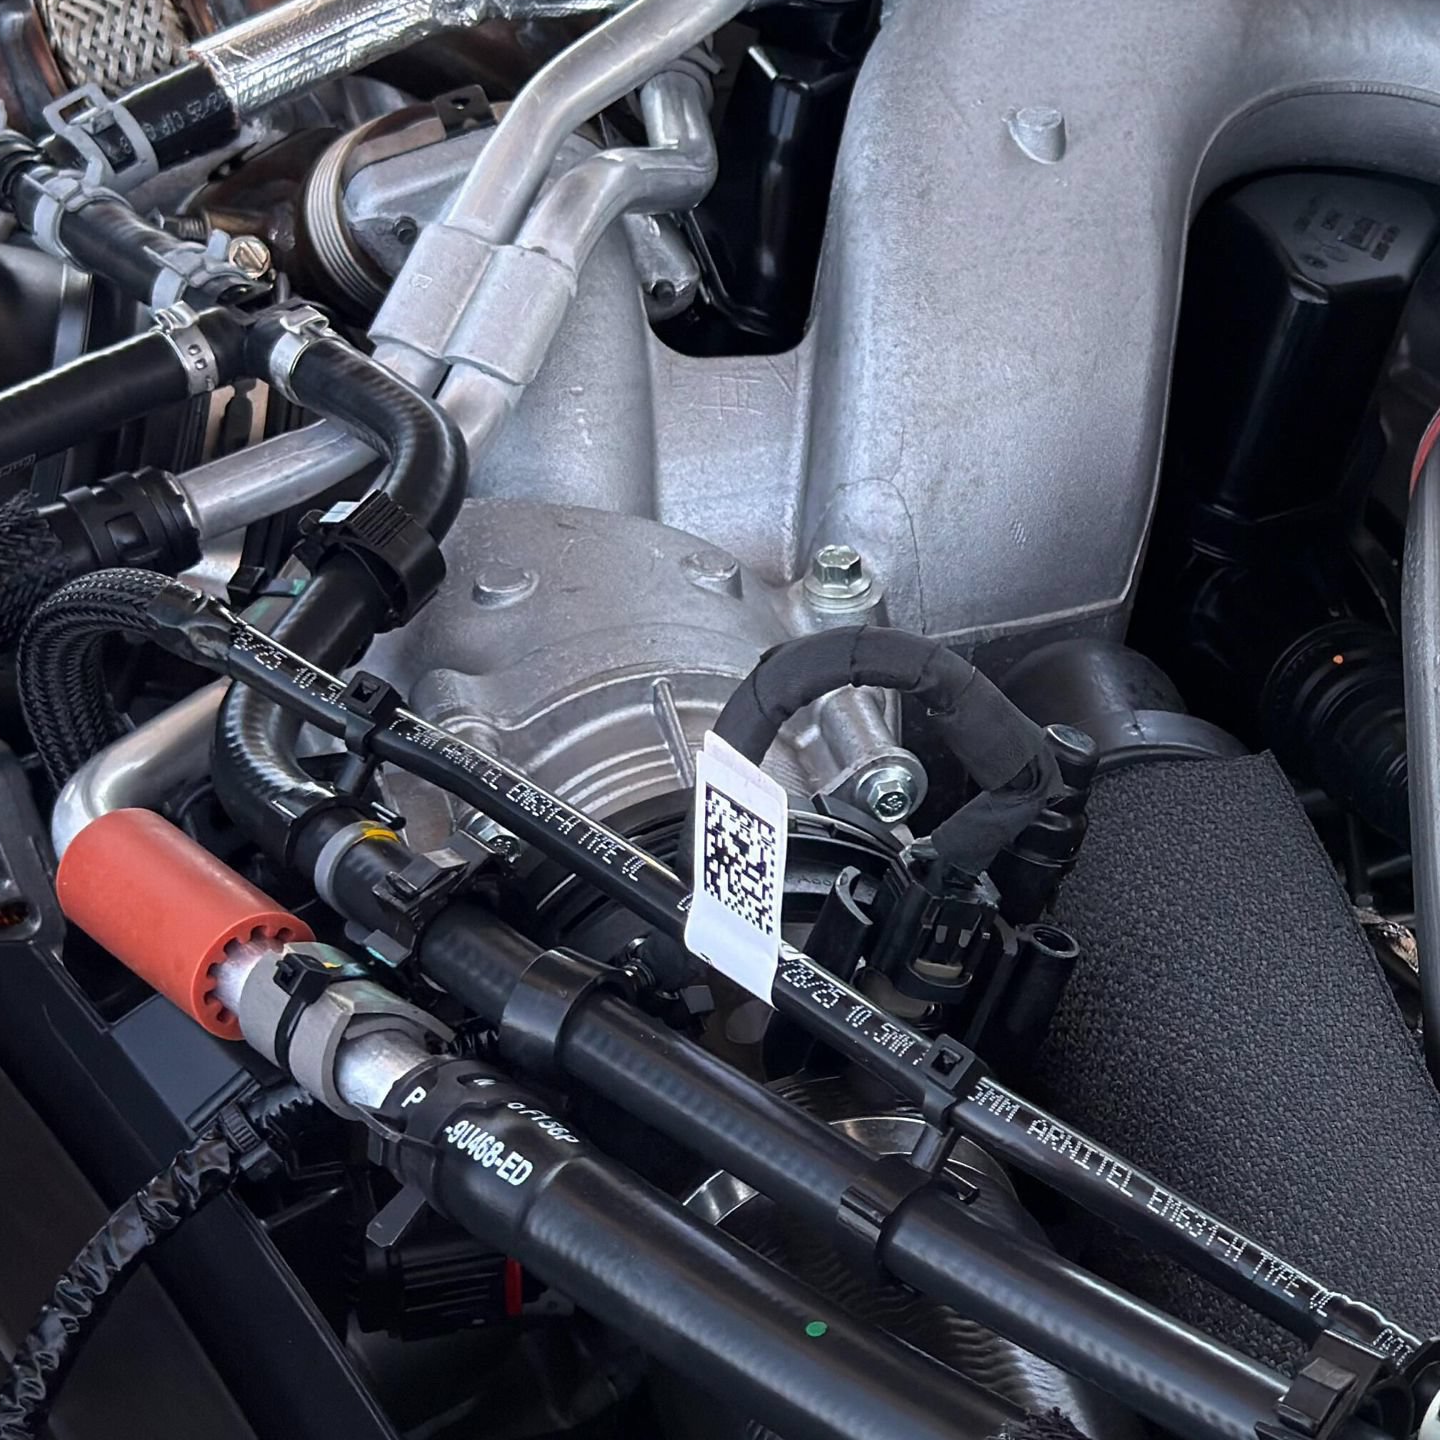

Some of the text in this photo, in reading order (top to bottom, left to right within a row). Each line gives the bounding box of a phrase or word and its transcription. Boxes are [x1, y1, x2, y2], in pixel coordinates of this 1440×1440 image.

[578, 825, 624, 864] TYPE
[1026, 1118, 1135, 1199] ARNITEL
[1145, 1187, 1249, 1263] EM631-H
[1252, 1252, 1302, 1298] TYPE
[1307, 1289, 1334, 1318] VL
